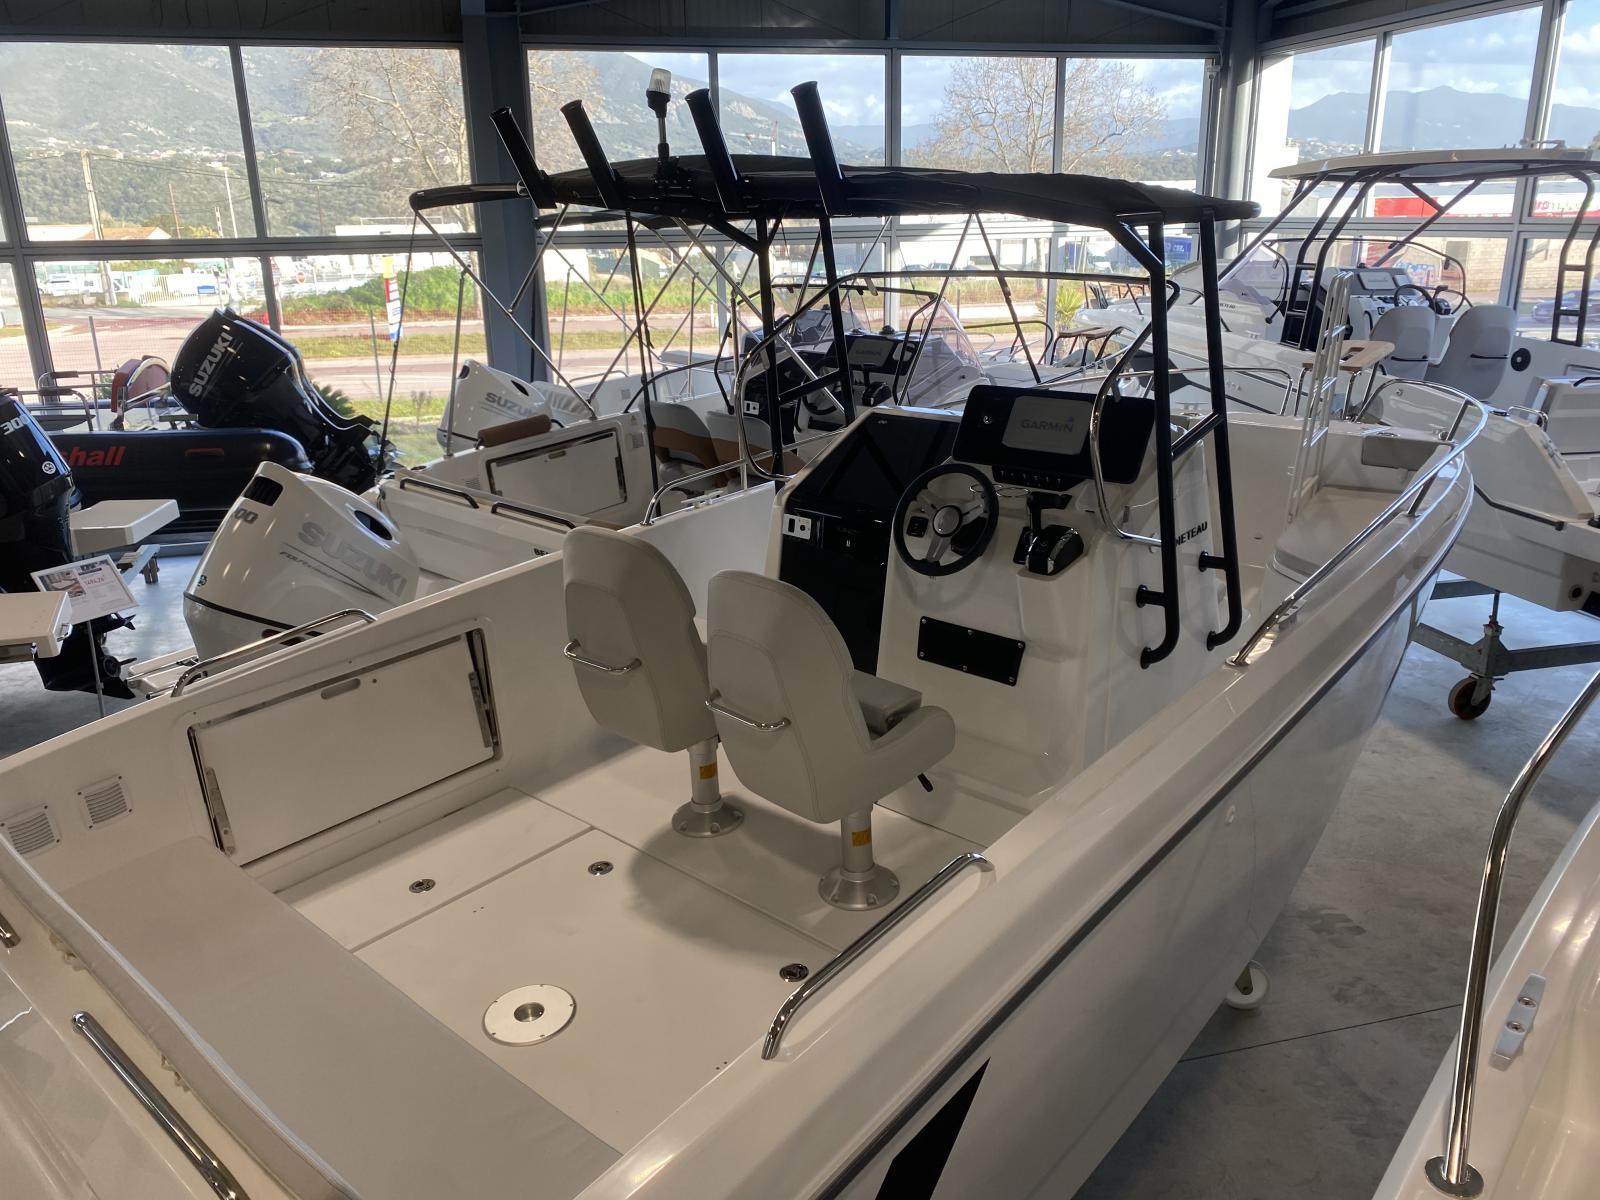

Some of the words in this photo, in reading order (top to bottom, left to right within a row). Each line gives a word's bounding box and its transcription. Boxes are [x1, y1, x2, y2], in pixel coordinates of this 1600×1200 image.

[189, 332, 233, 397] SUZUKI
[1020, 418, 1074, 432] GARMIN
[62, 445, 127, 466] hall
[1175, 520, 1208, 546] NETEAU
[298, 521, 408, 598] SUZUKI
